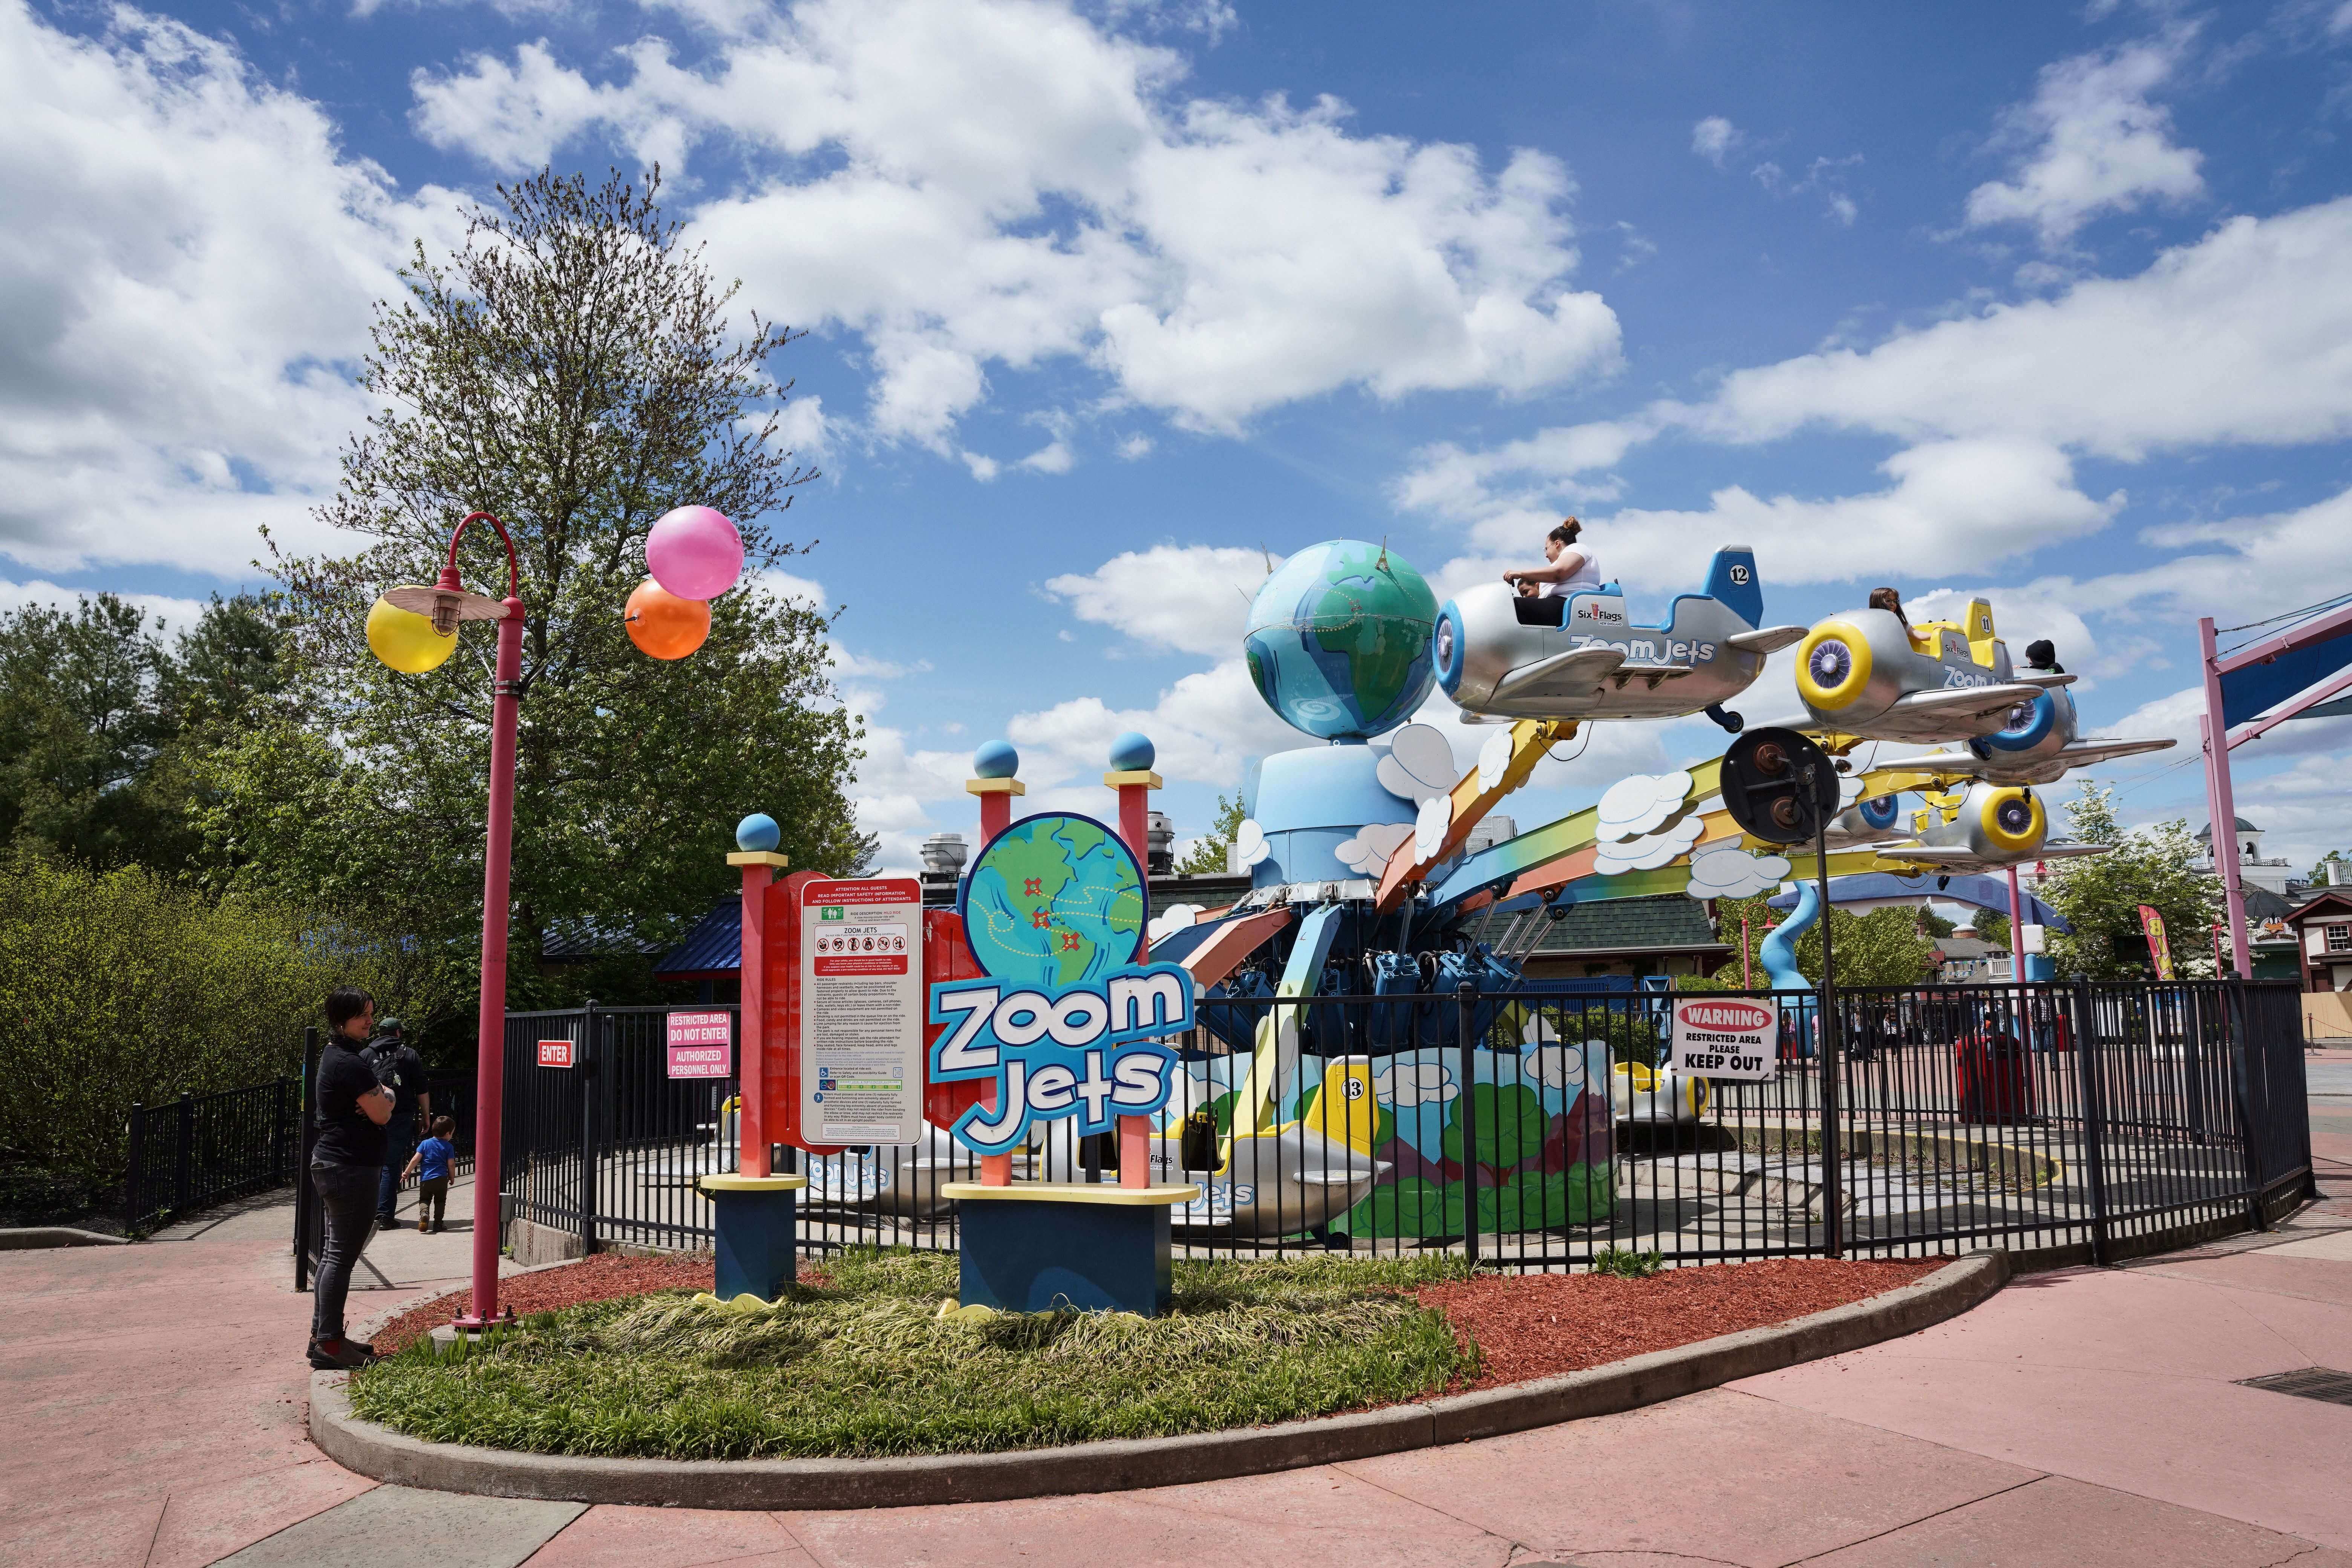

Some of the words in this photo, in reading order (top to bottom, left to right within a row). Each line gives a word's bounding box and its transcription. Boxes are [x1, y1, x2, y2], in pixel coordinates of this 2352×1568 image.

[1732, 567, 1747, 582] 12
[1599, 611, 1622, 621] Flags
[1982, 618, 1989, 630] 11
[1651, 639, 1715, 665] Jets
[1957, 648, 1969, 657] Flags
[671, 1015, 709, 1026] RESTRICTED
[709, 1014, 727, 1024] AREA
[938, 971, 1184, 1073] Zoom
[1687, 1007, 1764, 1027] WARNING
[671, 1030, 681, 1041] DO
[683, 1029, 700, 1040] NOT
[701, 1027, 727, 1040] ENTER
[1686, 1033, 1736, 1043] RESTRICTED
[1738, 1035, 1761, 1044] AREA
[541, 1046, 567, 1062] ENTER
[676, 1050, 721, 1062] AUTHORIZED
[1709, 1044, 1740, 1054] PLEASE
[672, 1064, 709, 1075] PERSONNEL
[710, 1064, 726, 1074] ONLY
[1685, 1054, 1724, 1069] KEEP
[1730, 1056, 1763, 1071] OUT
[962, 1049, 1167, 1145] Jets
[846, 1164, 887, 1187] Jets
